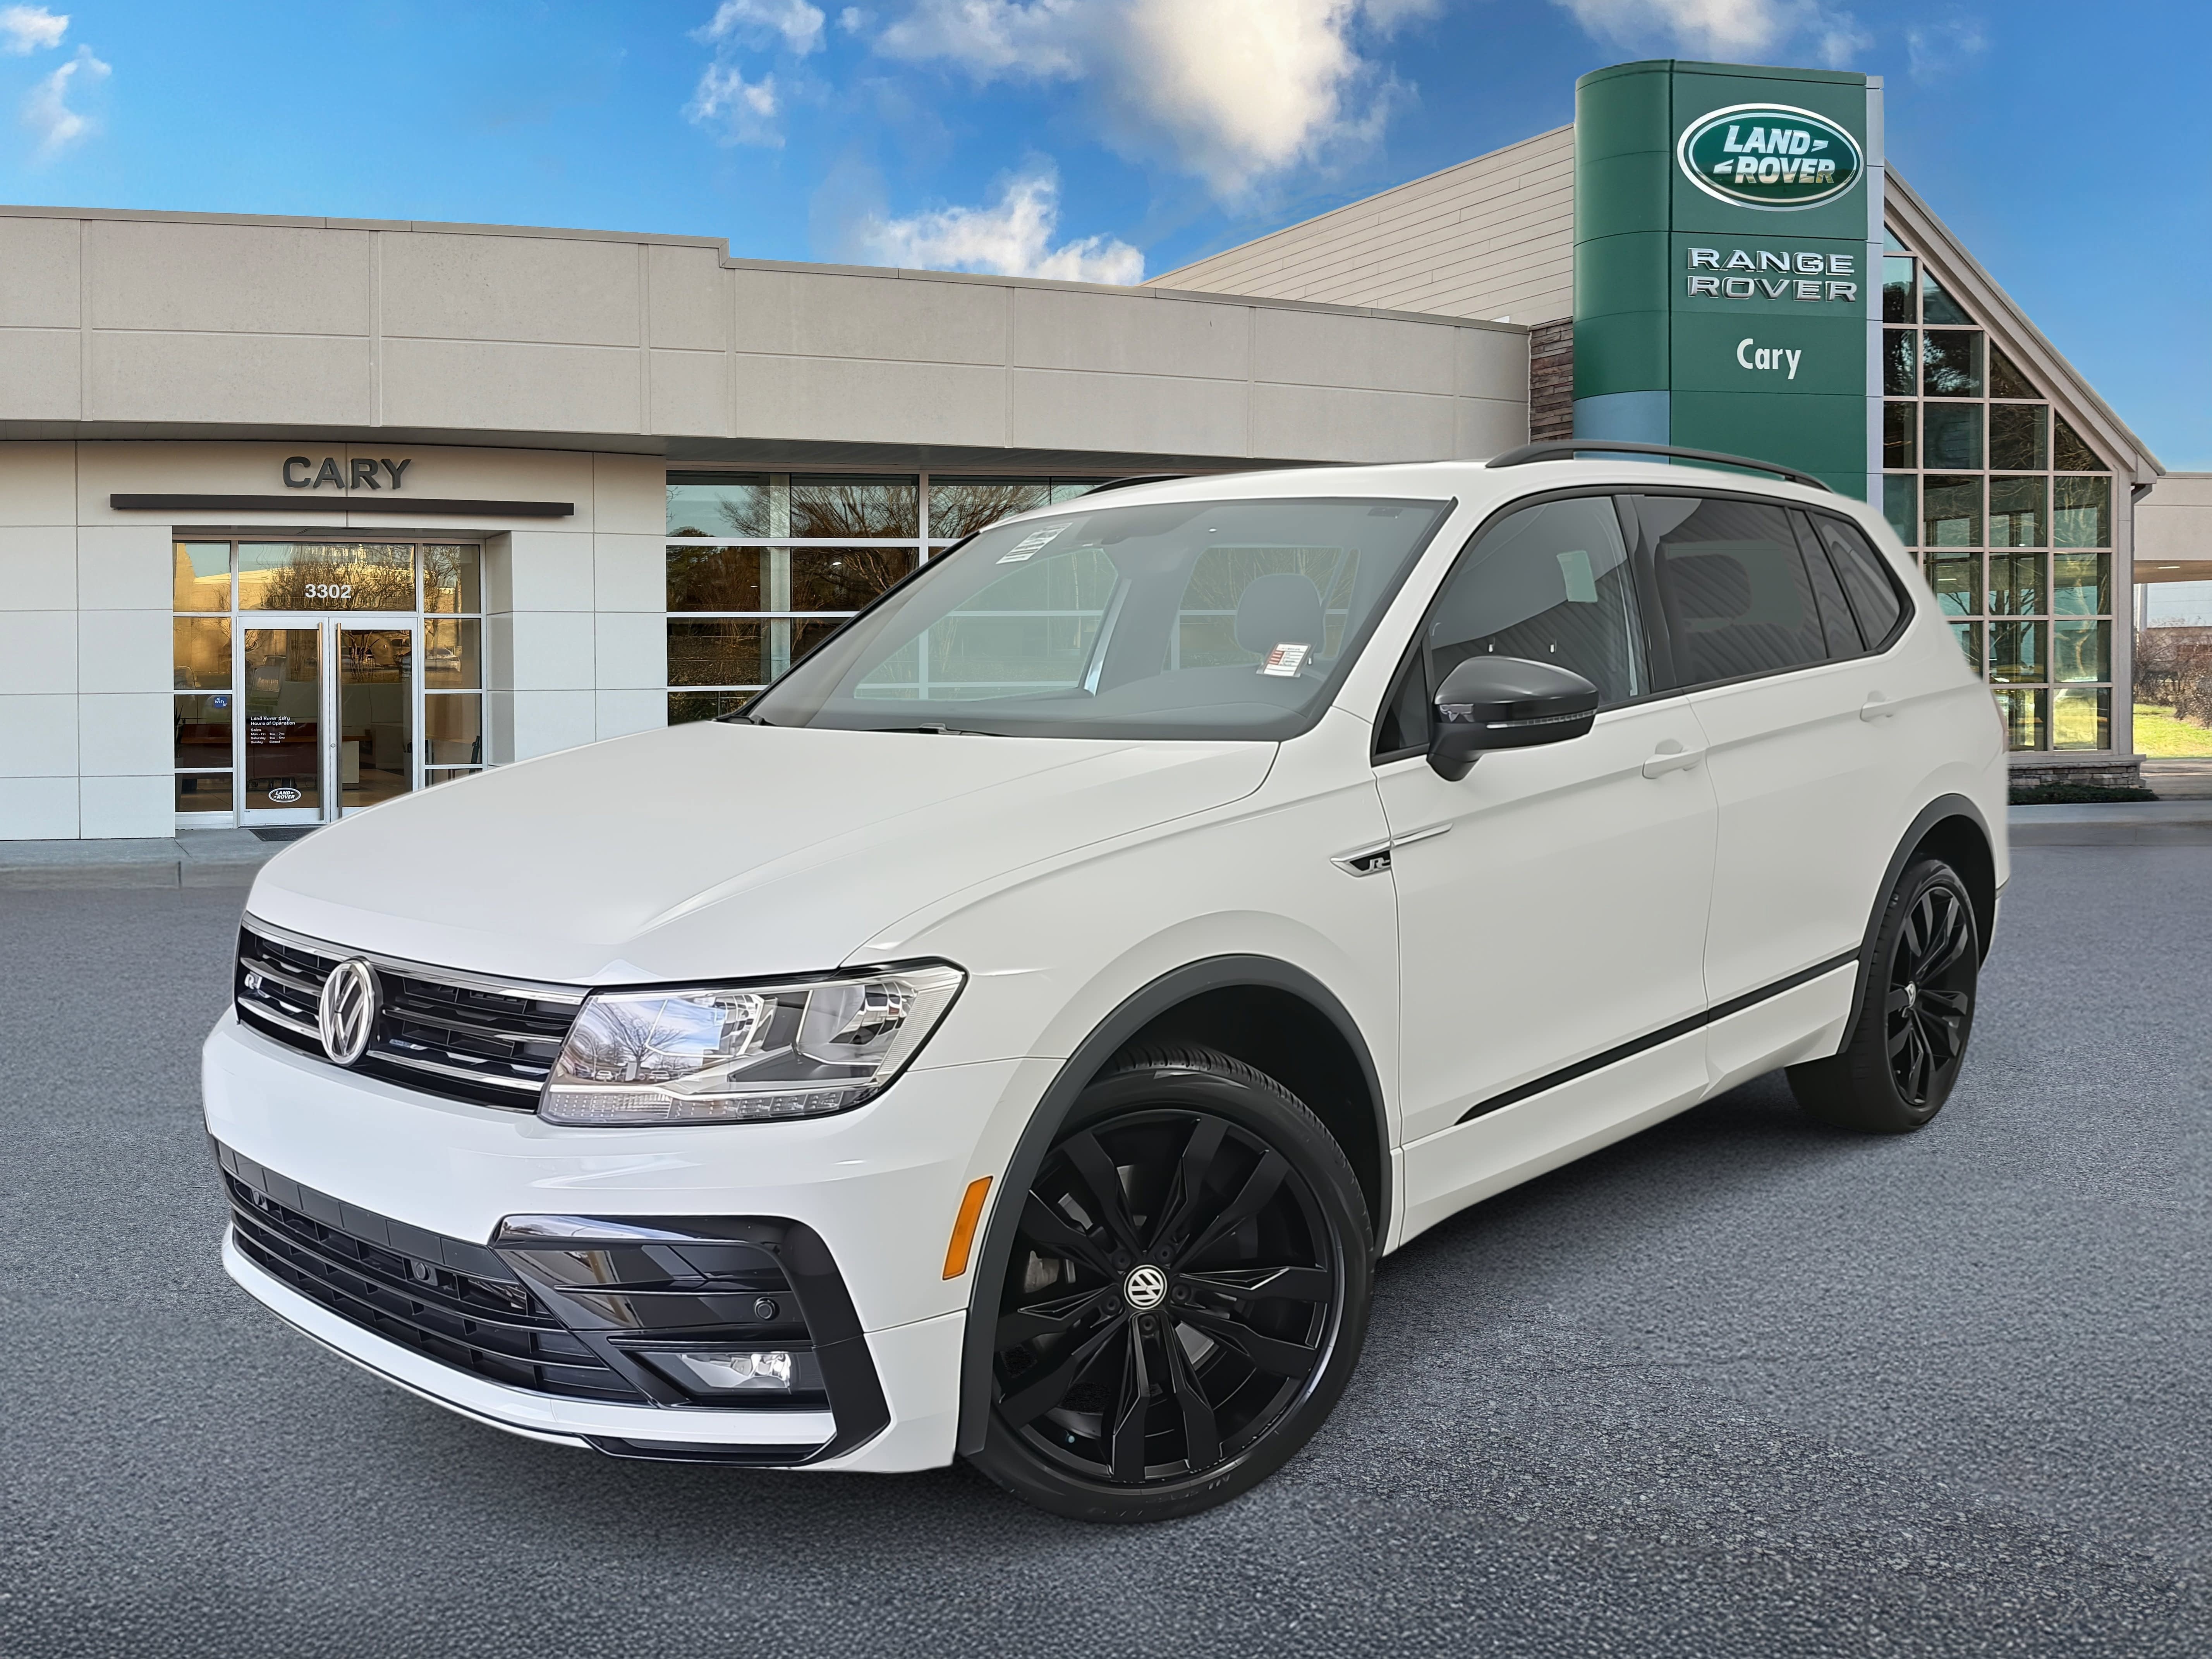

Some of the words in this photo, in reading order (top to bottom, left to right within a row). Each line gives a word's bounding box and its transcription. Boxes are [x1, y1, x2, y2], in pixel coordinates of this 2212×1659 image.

[1723, 125, 1811, 155] LAND
[1735, 156, 1836, 184] ROVER
[1687, 248, 1855, 275] RANGE
[1687, 275, 1858, 303] ROVER
[1736, 338, 1802, 380] Cary
[283, 456, 412, 489] CARY
[305, 584, 352, 598] 3302
